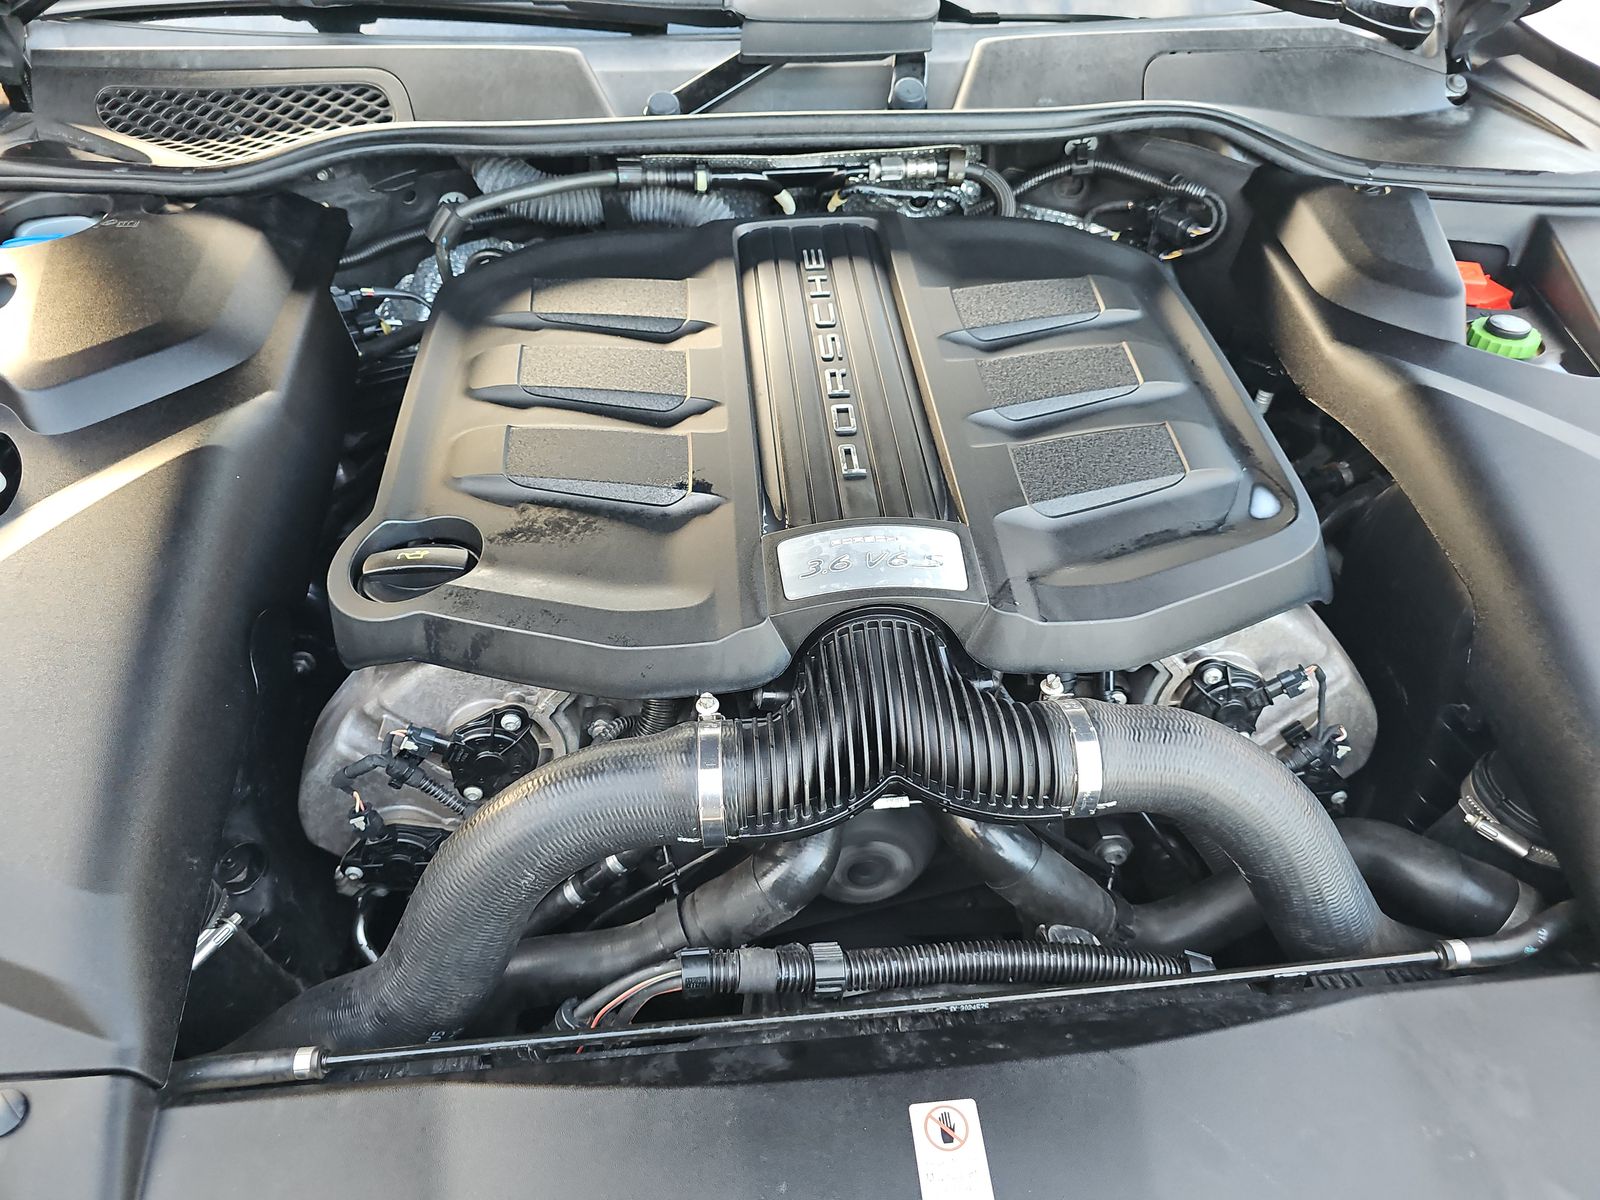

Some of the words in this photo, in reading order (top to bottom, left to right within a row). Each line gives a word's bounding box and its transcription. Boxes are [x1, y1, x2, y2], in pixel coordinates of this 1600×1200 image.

[802, 249, 867, 479] PORSCHE
[799, 554, 852, 580] 3.6
[865, 551, 908, 569] V6
